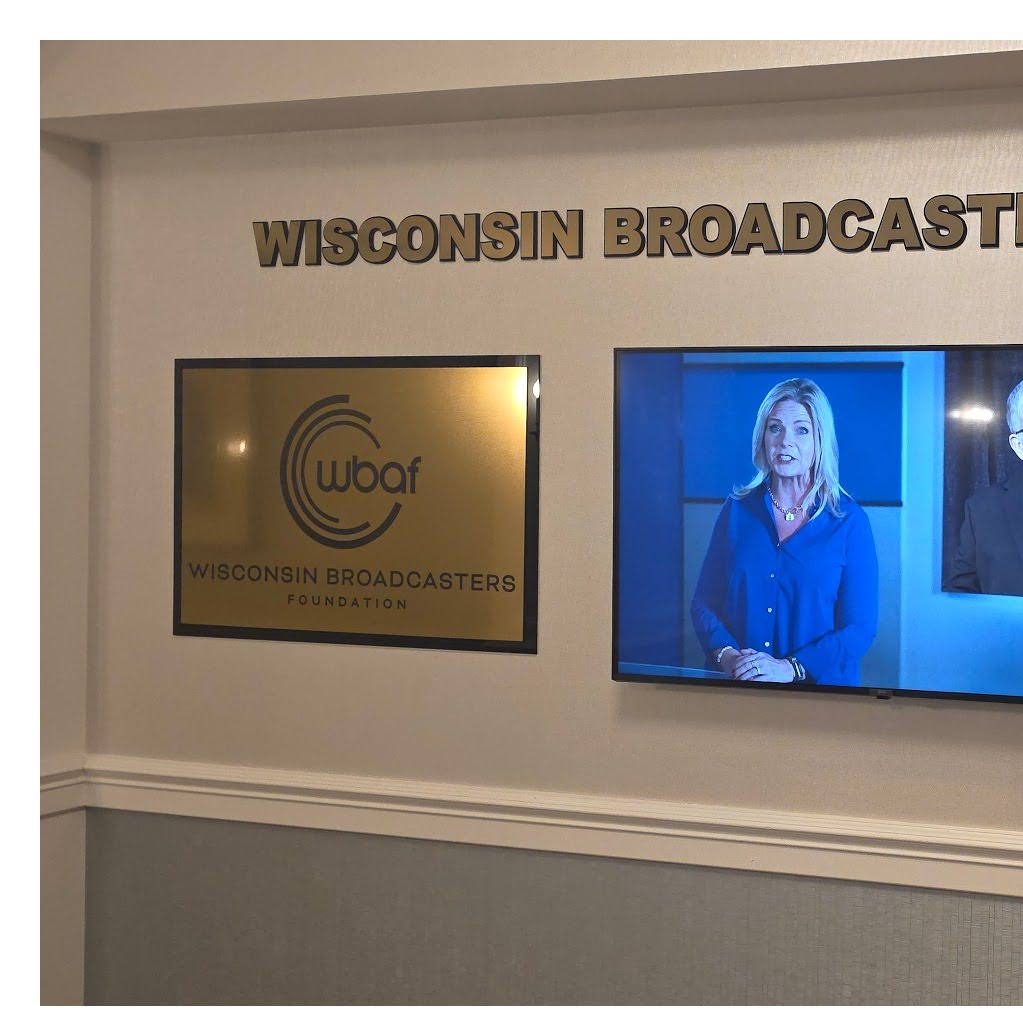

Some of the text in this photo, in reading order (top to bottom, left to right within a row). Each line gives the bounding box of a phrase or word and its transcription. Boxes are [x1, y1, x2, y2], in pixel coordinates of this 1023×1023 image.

[253, 210, 583, 266] WISCONSIN
[317, 455, 421, 494] wbaf
[189, 562, 516, 592] WISCONSIN BROADCASTERS
[288, 594, 407, 609] FOUNDATION
